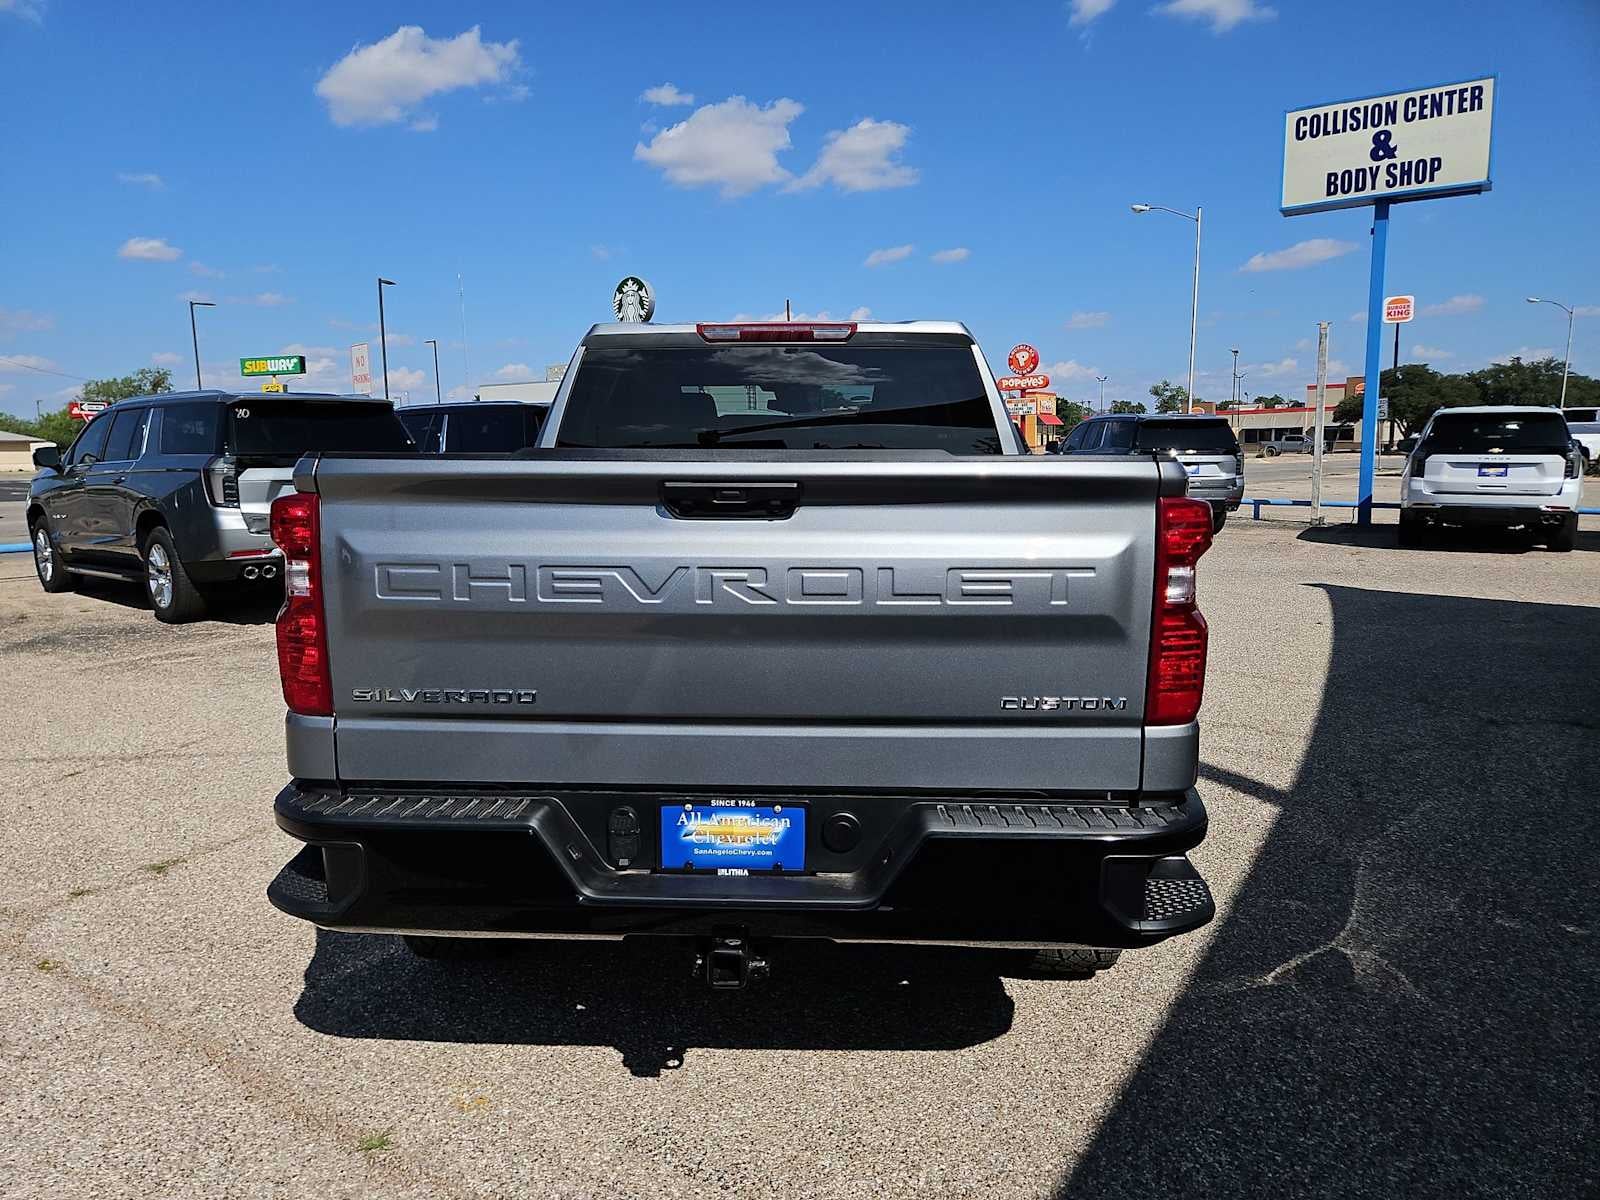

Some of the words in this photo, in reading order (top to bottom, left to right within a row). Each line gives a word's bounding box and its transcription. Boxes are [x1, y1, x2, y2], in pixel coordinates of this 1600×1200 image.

[1295, 100, 1398, 141] COLLISION
[1403, 85, 1484, 123] CENTER
[1370, 130, 1397, 162] &
[1326, 165, 1380, 197] BODY
[1385, 157, 1442, 189] SHOP
[1386, 309, 1411, 318] KING
[243, 358, 296, 373] SUBWAY
[355, 355, 365, 368] NO
[375, 563, 1097, 605] CHEVROLET
[352, 688, 537, 704] SILVERADO
[1000, 697, 1128, 711] CUSTOM
[738, 800, 756, 808] 1946
[676, 811, 701, 827] All
[708, 812, 791, 828] American
[692, 830, 779, 846] Chevrolet
[693, 848, 773, 857] SanAngeloChevy.com
